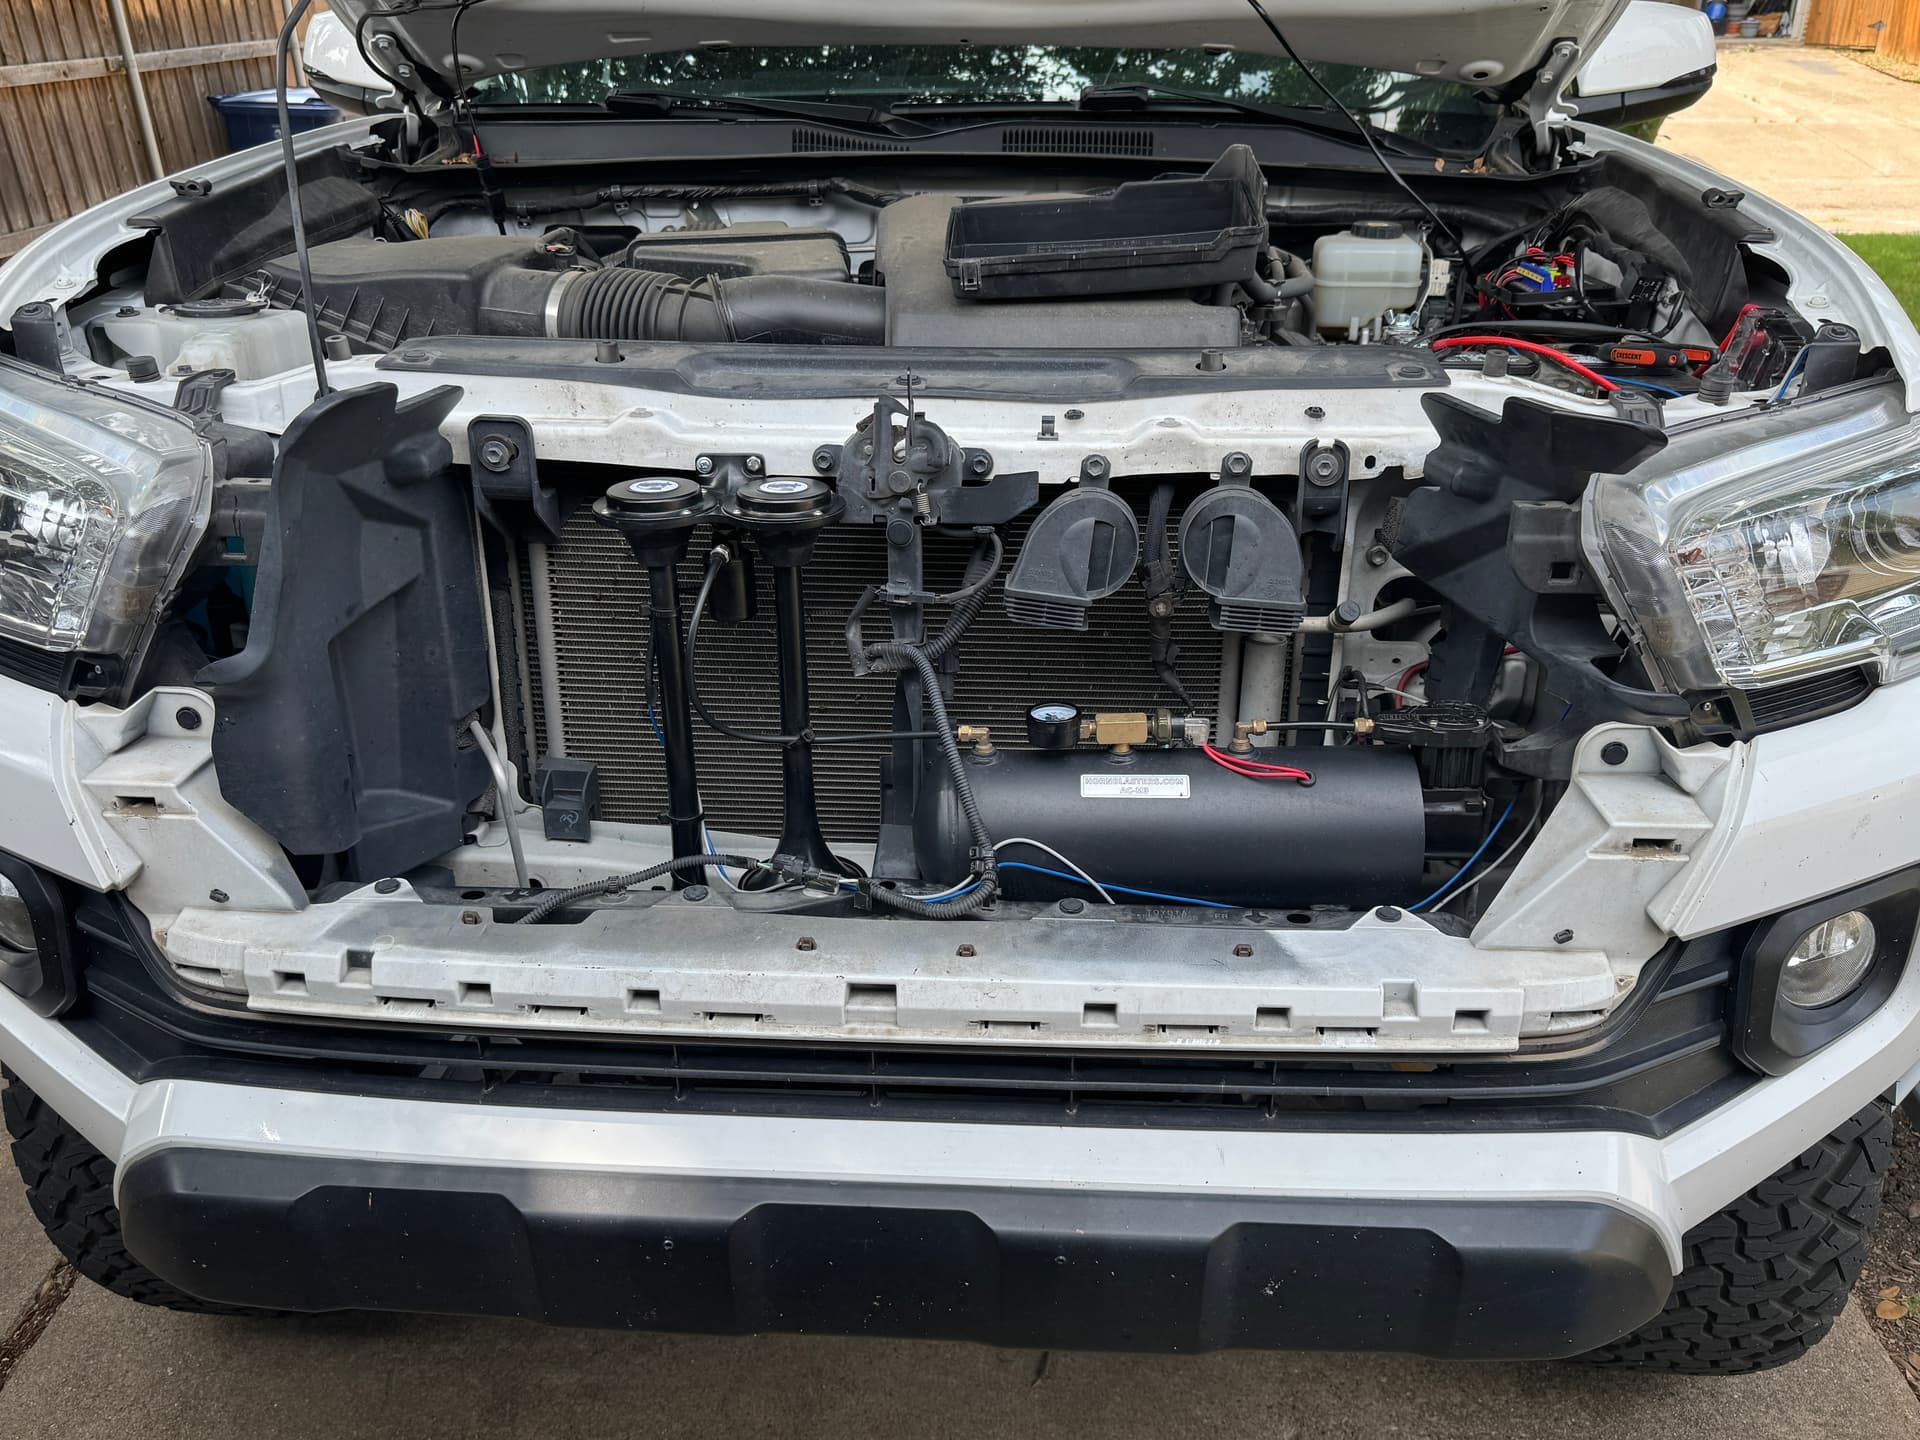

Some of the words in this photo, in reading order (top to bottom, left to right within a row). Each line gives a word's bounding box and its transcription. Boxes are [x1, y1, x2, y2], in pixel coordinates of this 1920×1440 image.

[1616, 352, 1642, 361] CRESCENT
[1084, 776, 1184, 786] HORNBLASTERS.COM
[1146, 908, 1188, 917] TOYOTA
